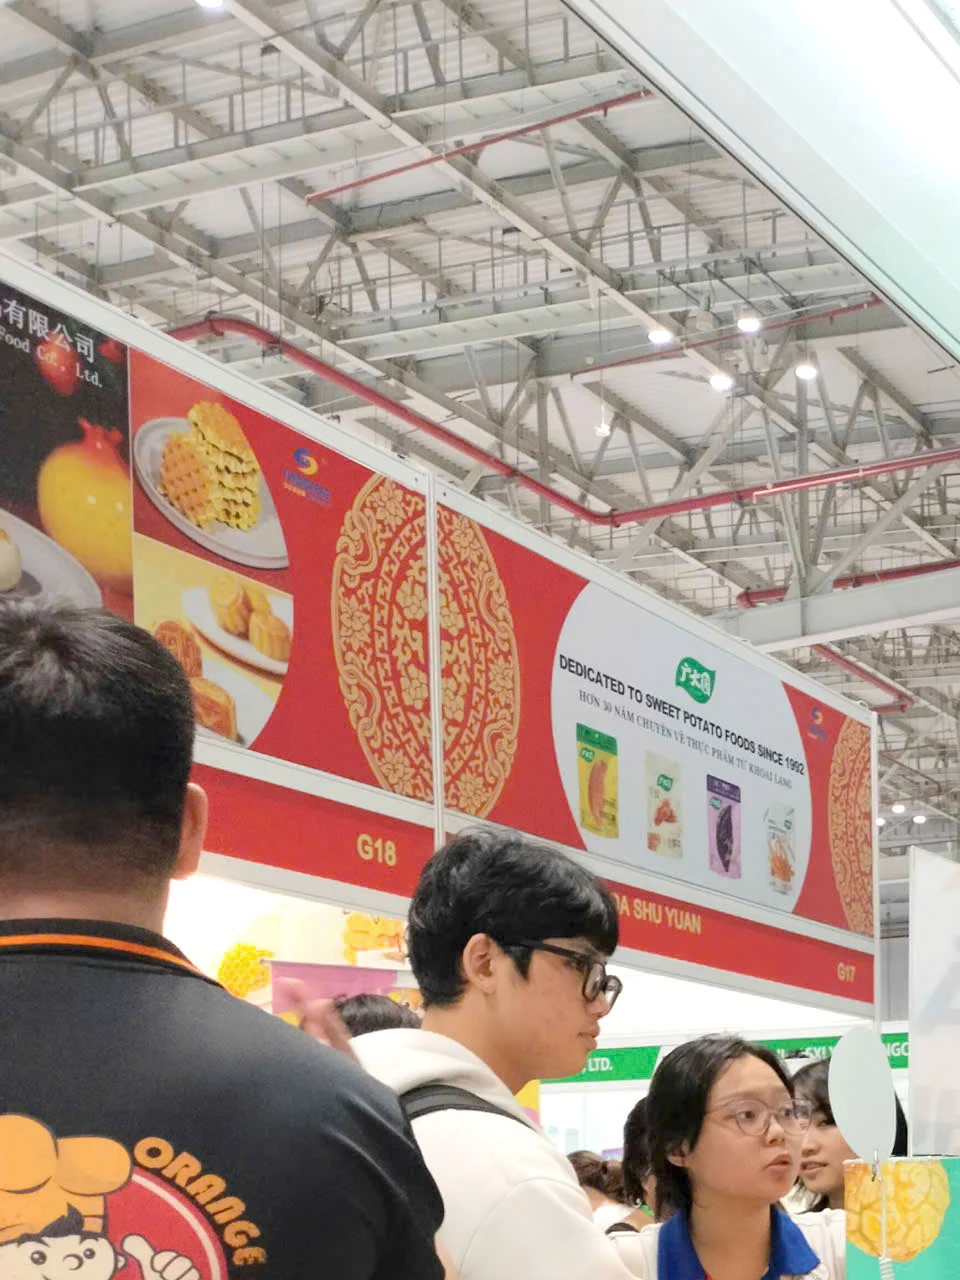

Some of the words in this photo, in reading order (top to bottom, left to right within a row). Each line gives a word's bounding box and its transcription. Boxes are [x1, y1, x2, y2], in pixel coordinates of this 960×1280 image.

[0, 299, 95, 364] 有限公司
[559, 653, 625, 696] DEDICATED
[627, 685, 643, 703] TO
[645, 693, 681, 721] SWEET
[683, 710, 723, 739] POTATO
[724, 729, 755, 754] FOODS
[757, 744, 783, 767] SINCE
[785, 757, 805, 775] 1992
[356, 833, 397, 867] G18
[633, 898, 662, 925] SHU
[664, 906, 701, 935] YUAN
[837, 962, 857, 983] G17
[134, 1136, 267, 1266] ORANGE
